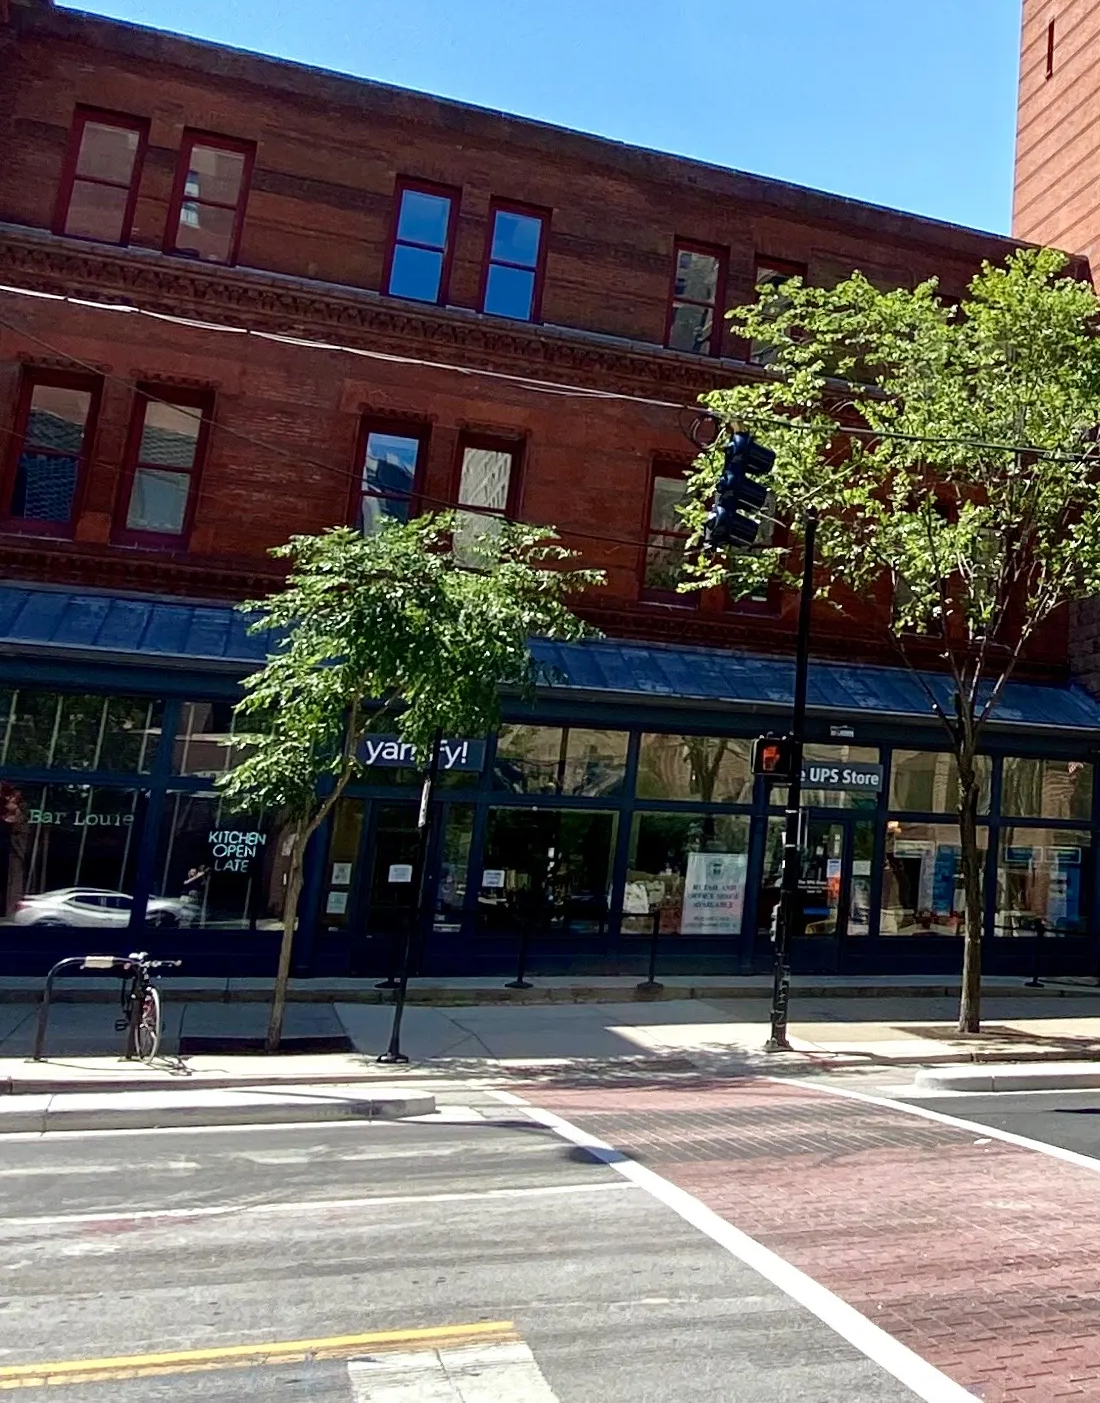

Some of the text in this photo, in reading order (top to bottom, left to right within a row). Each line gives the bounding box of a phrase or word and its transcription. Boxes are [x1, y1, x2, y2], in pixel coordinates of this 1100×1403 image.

[809, 767, 840, 783] UPS
[842, 769, 879, 785] Store
[27, 809, 135, 826] Bar Louie
[208, 830, 266, 846] KITCHEN
[213, 843, 256, 858] OPEN
[214, 859, 249, 873] LATE
